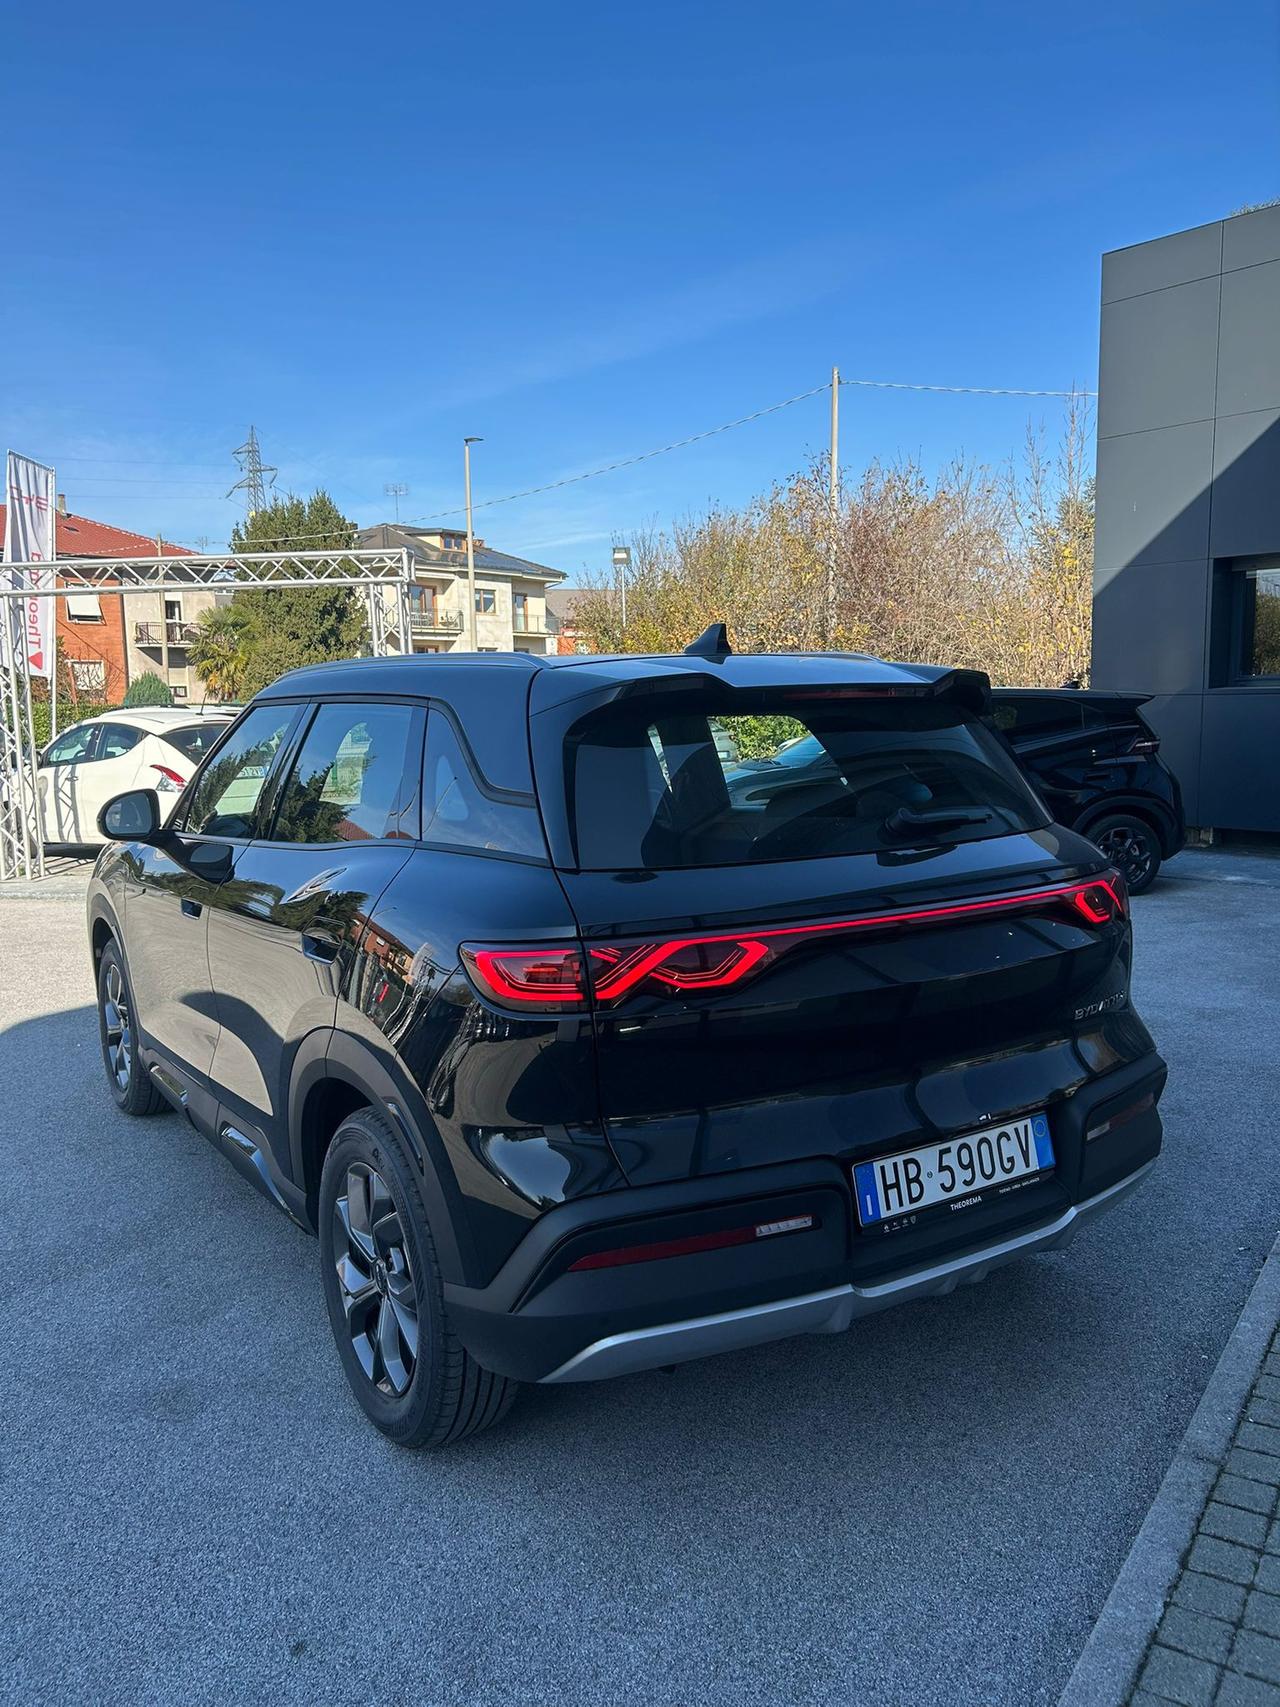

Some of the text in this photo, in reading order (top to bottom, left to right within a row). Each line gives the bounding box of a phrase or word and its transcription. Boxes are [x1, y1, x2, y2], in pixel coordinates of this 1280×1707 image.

[880, 1124, 1031, 1211] HB 590GV
[950, 1195, 982, 1210] THEOREMA
